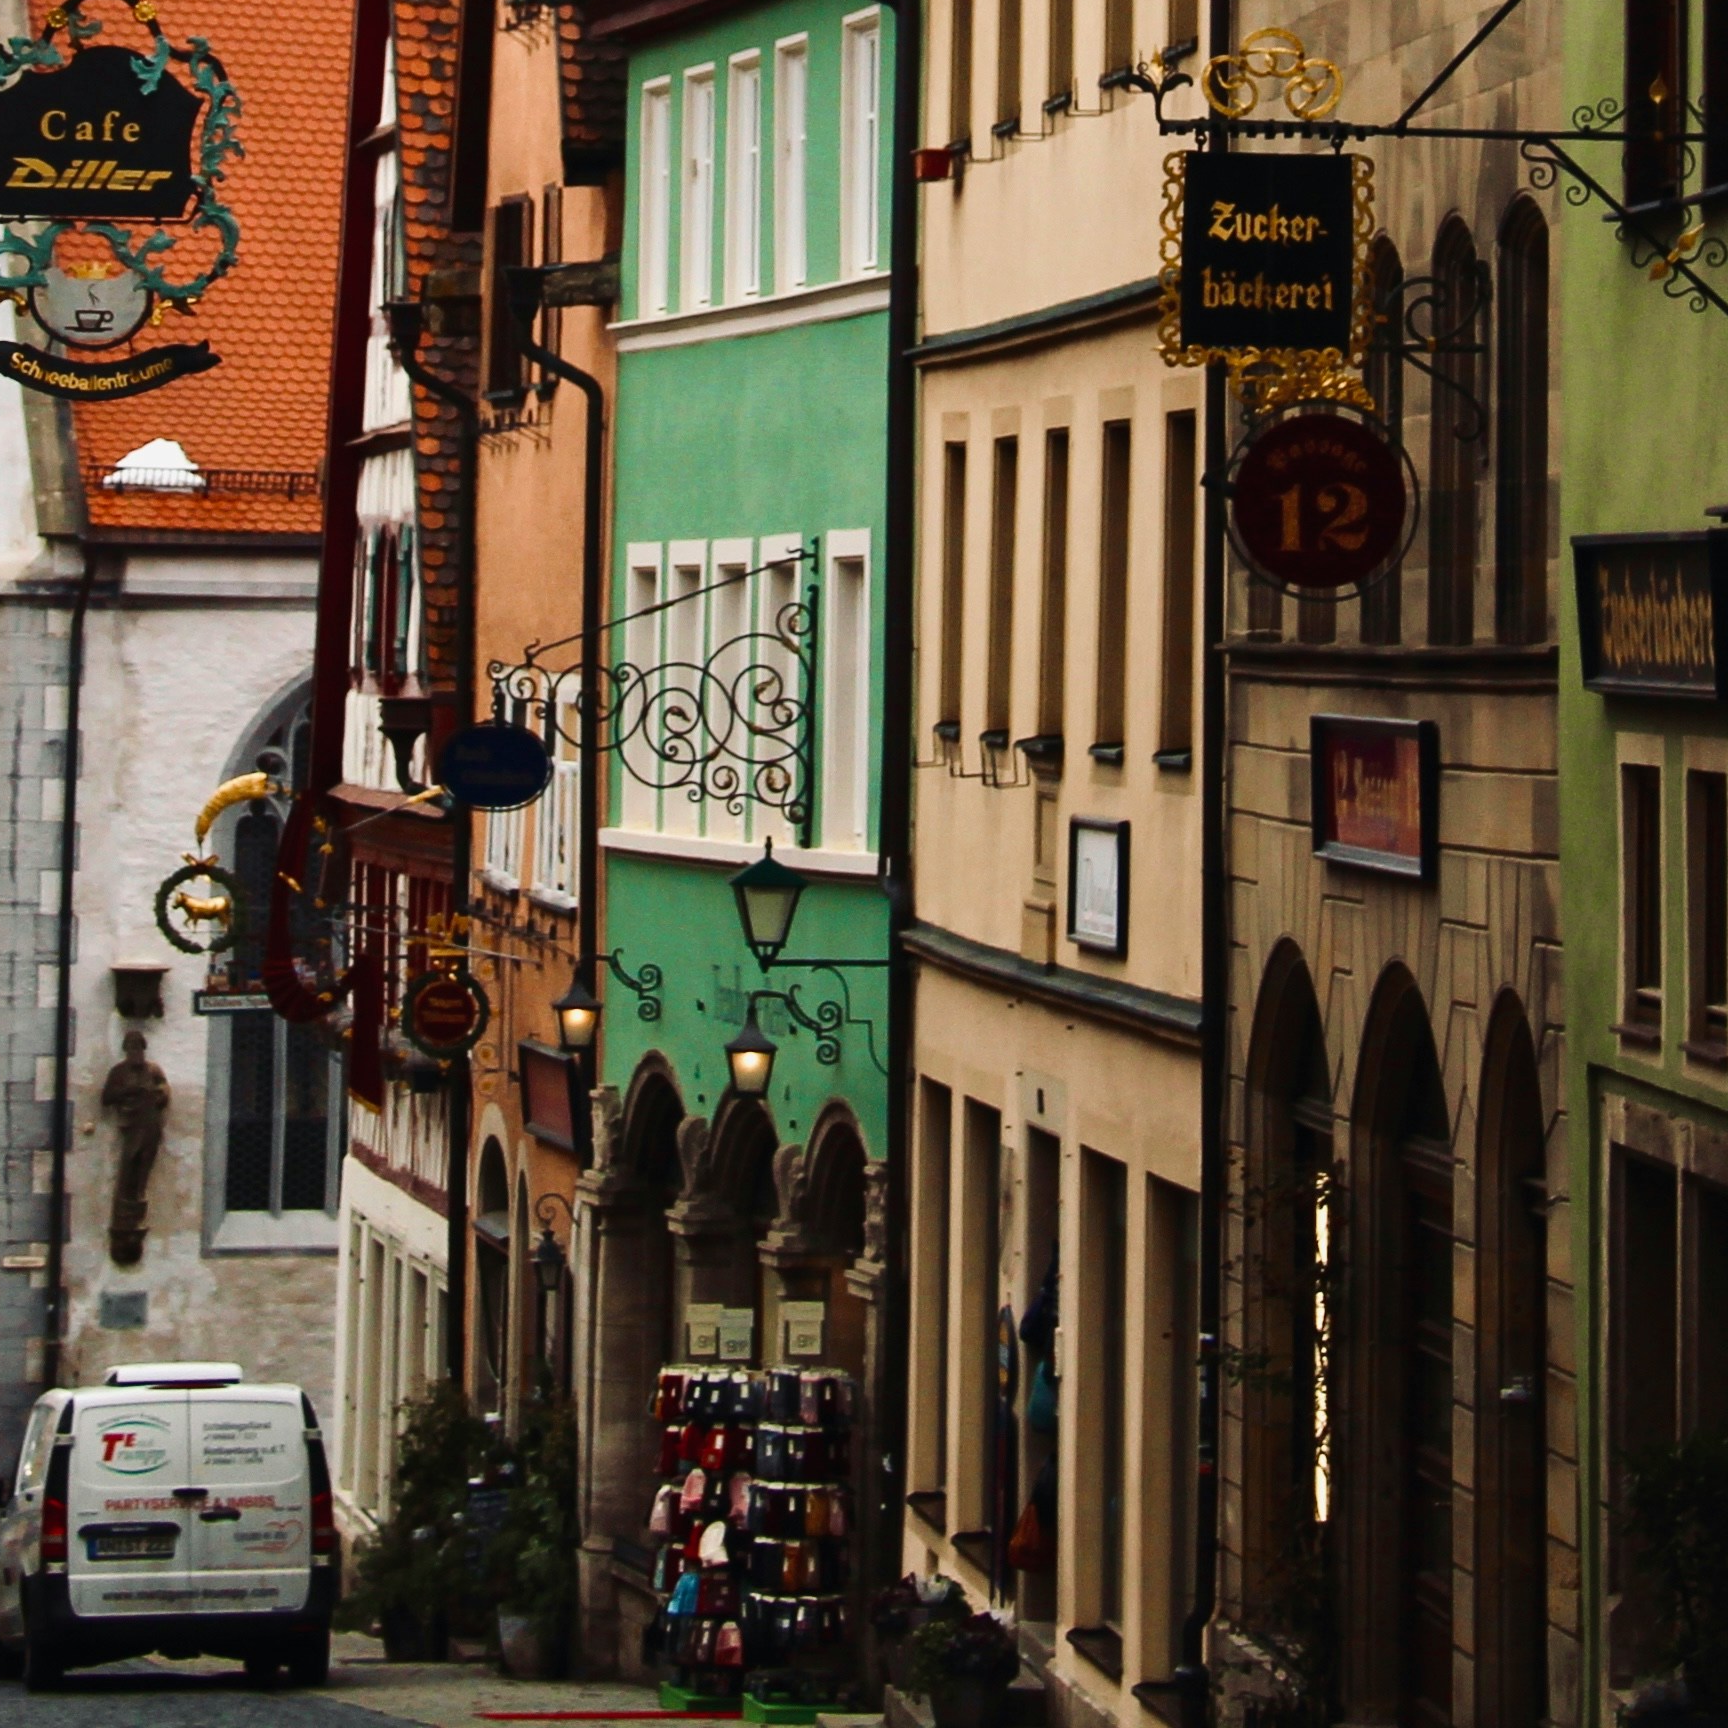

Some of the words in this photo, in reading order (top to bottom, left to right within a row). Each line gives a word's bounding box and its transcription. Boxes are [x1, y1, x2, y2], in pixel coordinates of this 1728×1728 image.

[38, 108, 143, 144] Cafe
[3, 156, 175, 193] Diller
[1206, 199, 1329, 256] Zucker-
[1200, 263, 1334, 315] bäckerei
[1268, 482, 1370, 553] 12
